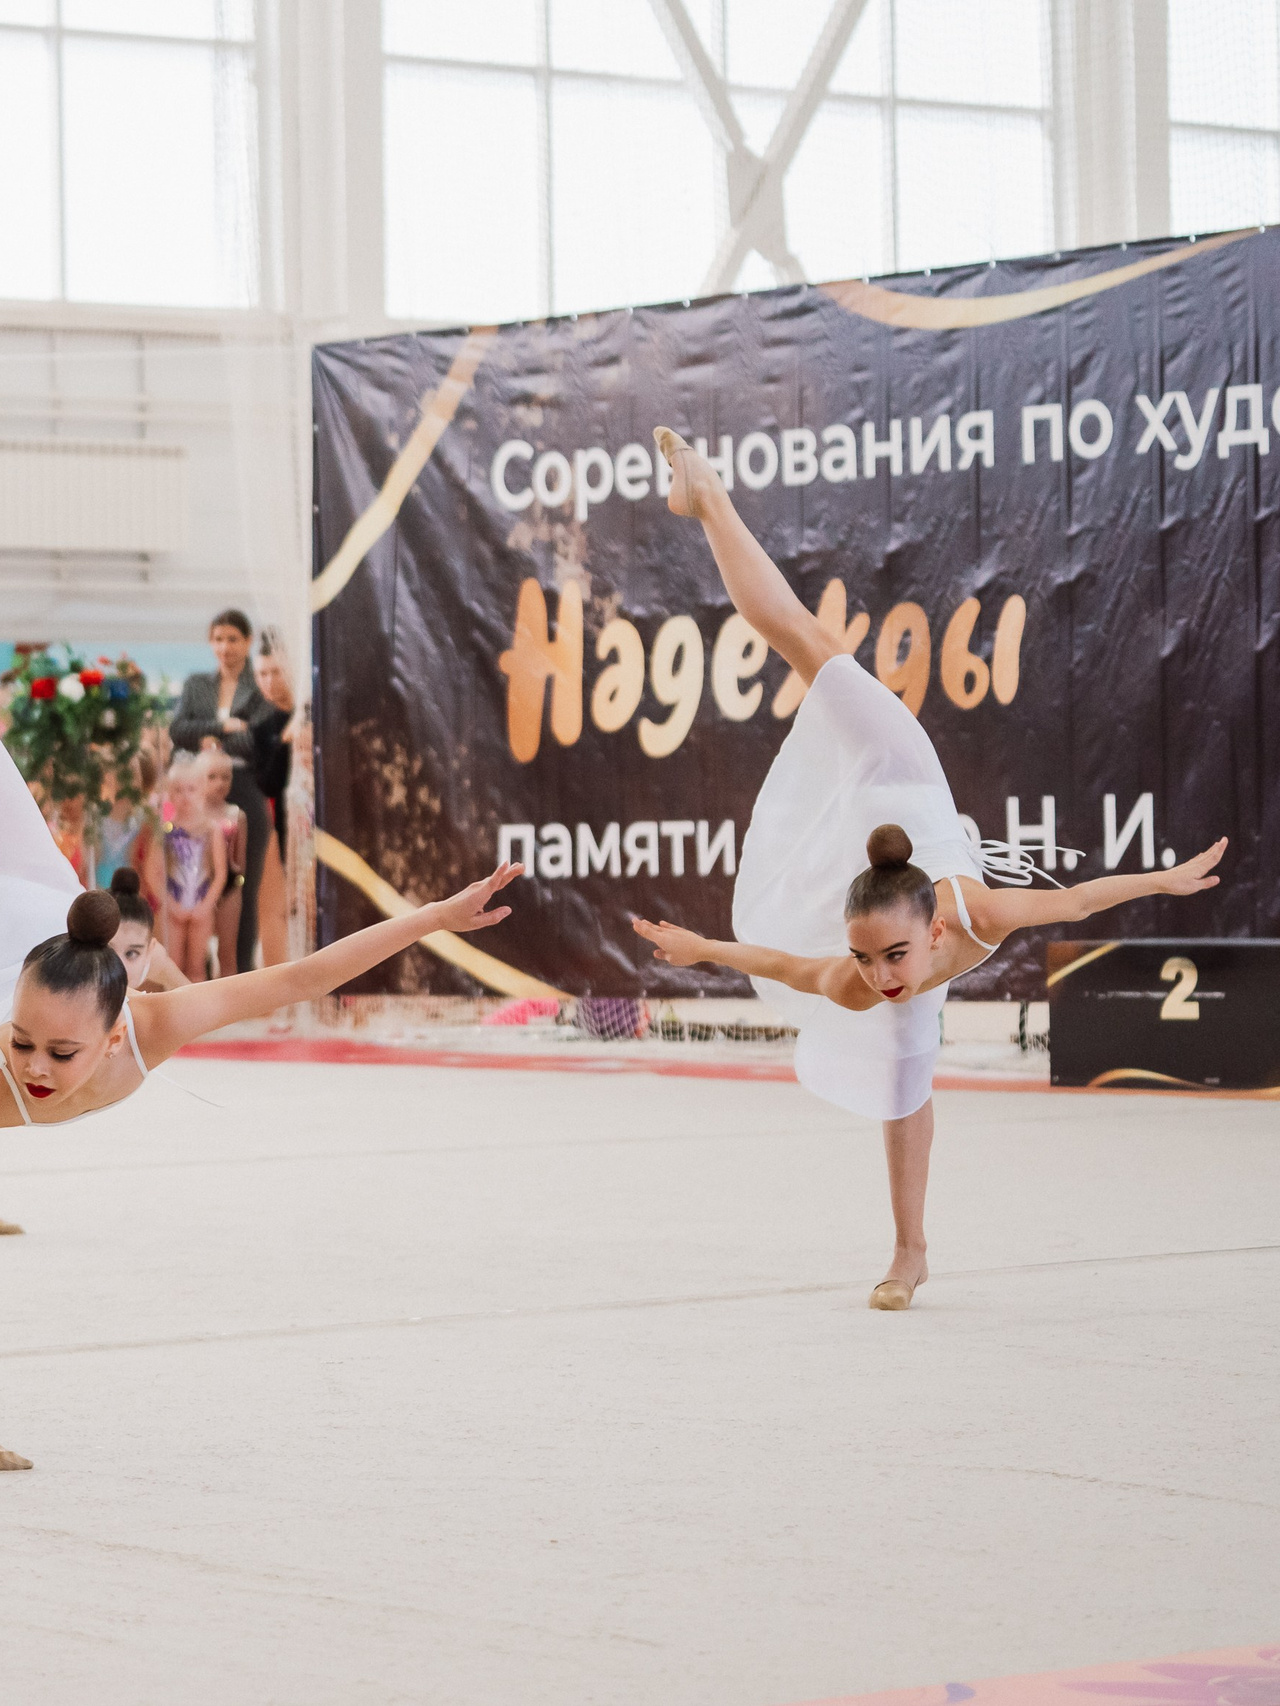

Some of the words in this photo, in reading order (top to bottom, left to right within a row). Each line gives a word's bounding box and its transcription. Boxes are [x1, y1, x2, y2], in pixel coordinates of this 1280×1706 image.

[1021, 399, 1113, 465] по
[1135, 383, 1280, 471] худ
[497, 819, 736, 879] памяти
[1103, 792, 1176, 870] И.
[1160, 956, 1200, 1020] 2
